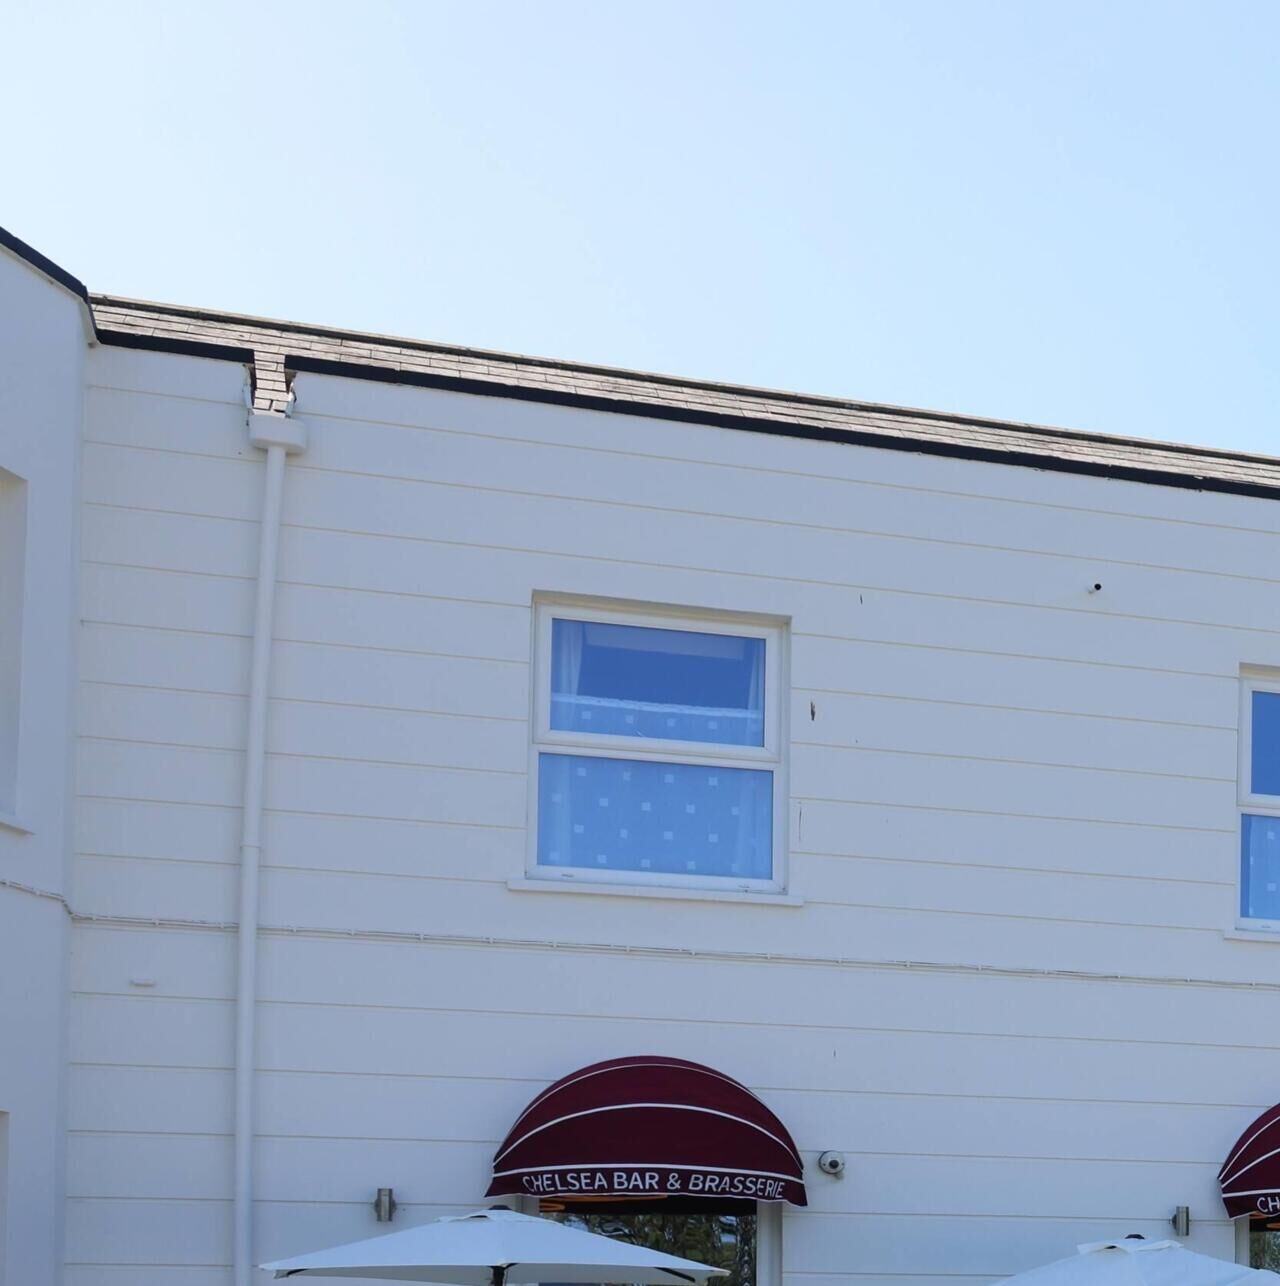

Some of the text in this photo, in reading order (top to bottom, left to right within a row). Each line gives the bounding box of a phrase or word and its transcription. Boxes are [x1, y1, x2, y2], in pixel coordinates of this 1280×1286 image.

[522, 1172, 785, 1198] CHELSEA BAR & BRASSERIE
